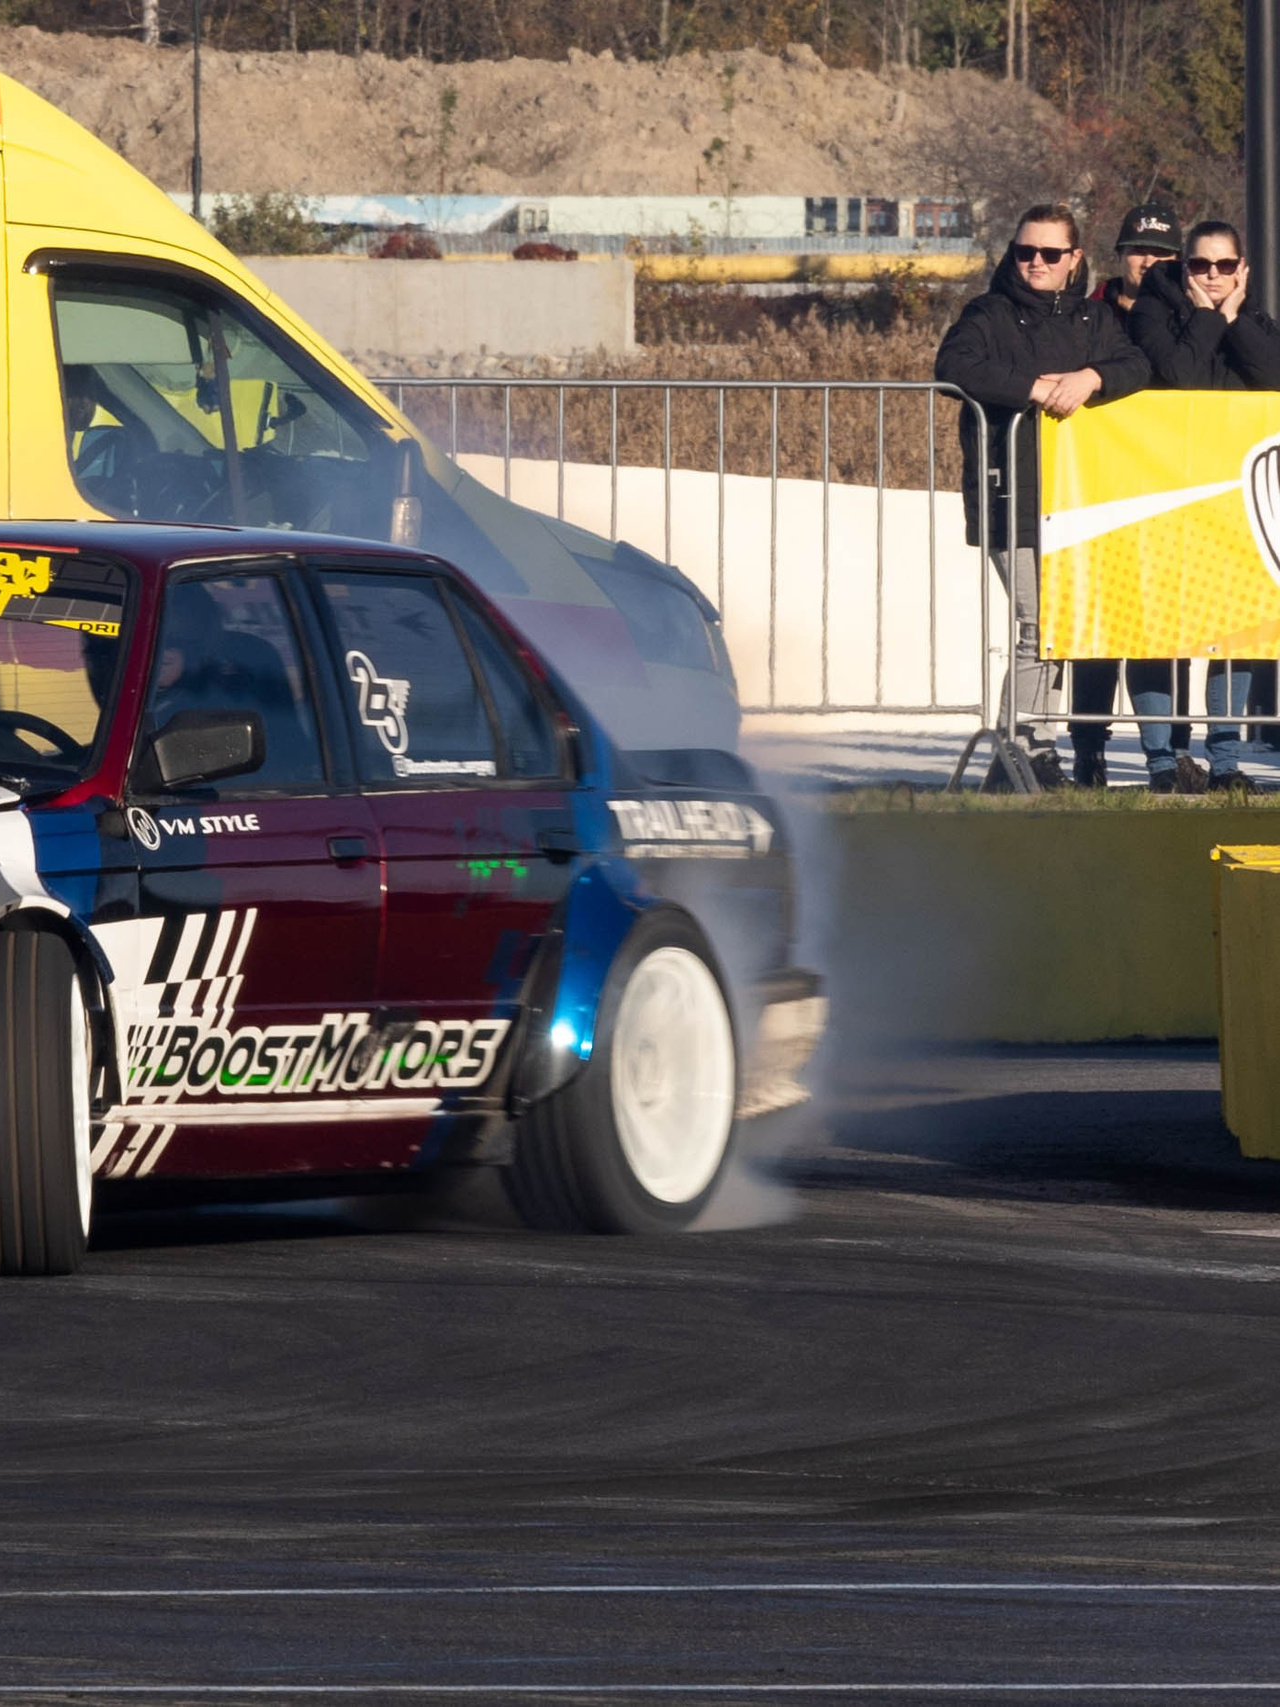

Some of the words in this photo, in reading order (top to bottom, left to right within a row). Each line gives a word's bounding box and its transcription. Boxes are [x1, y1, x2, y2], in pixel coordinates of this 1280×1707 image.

[78, 622, 116, 634] DRI
[159, 818, 196, 836] VM
[199, 814, 261, 834] STYLE
